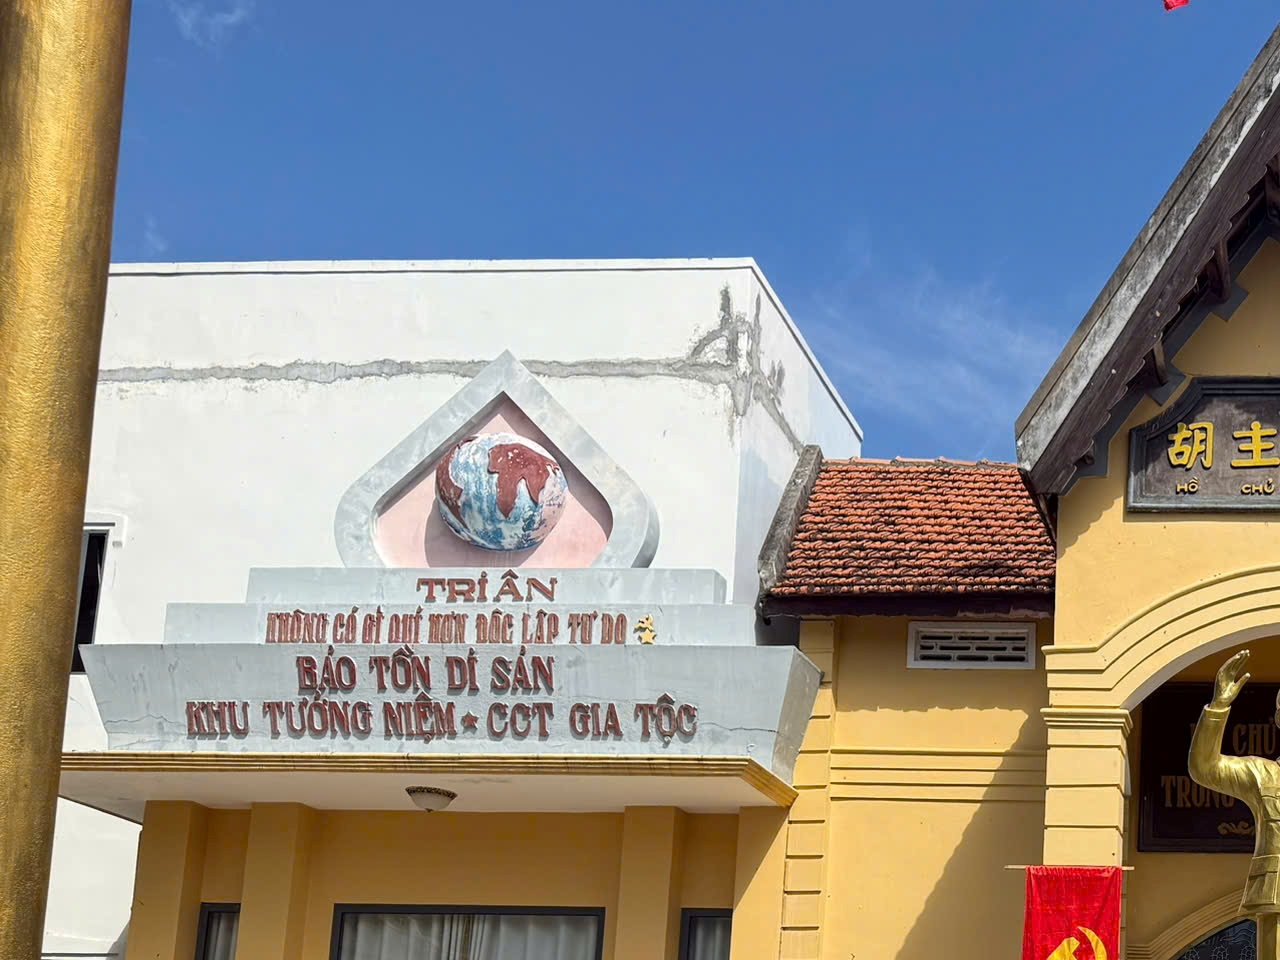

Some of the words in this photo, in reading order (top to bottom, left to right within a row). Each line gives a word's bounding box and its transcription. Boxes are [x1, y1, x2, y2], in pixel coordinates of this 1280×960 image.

[1176, 477, 1198, 493] HỒ
[1241, 479, 1275, 494] CHỦ
[493, 569, 558, 602] ÂN
[333, 605, 358, 643] CÓ
[601, 613, 627, 644] DO
[296, 645, 357, 690] BẢO
[369, 643, 431, 690] TỒN
[491, 645, 555, 691] SẢN
[186, 701, 249, 735] KHU
[262, 690, 374, 735] TƯỞNG
[383, 691, 457, 742] NIỆM
[569, 703, 623, 736] GIA
[635, 692, 697, 744] TỘC
[1232, 716, 1276, 755] CHỦ
